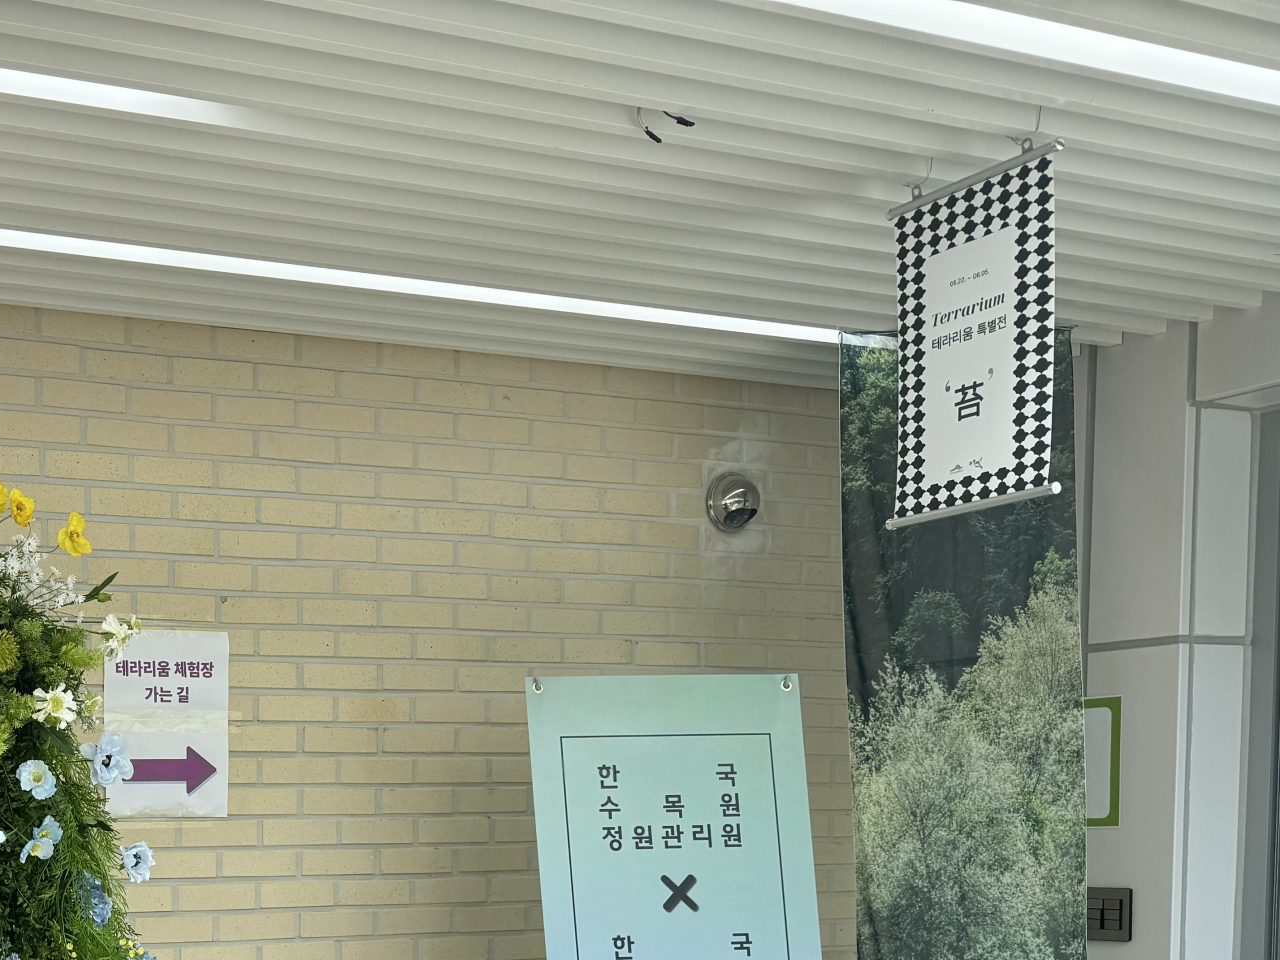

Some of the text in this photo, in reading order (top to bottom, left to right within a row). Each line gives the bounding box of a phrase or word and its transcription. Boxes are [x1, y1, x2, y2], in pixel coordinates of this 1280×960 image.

[931, 293, 1005, 328] Terrarium
[931, 313, 1008, 350] 테라리움 특별전
[115, 660, 215, 678] 테라리움 체험장
[144, 686, 190, 704] 가는 길
